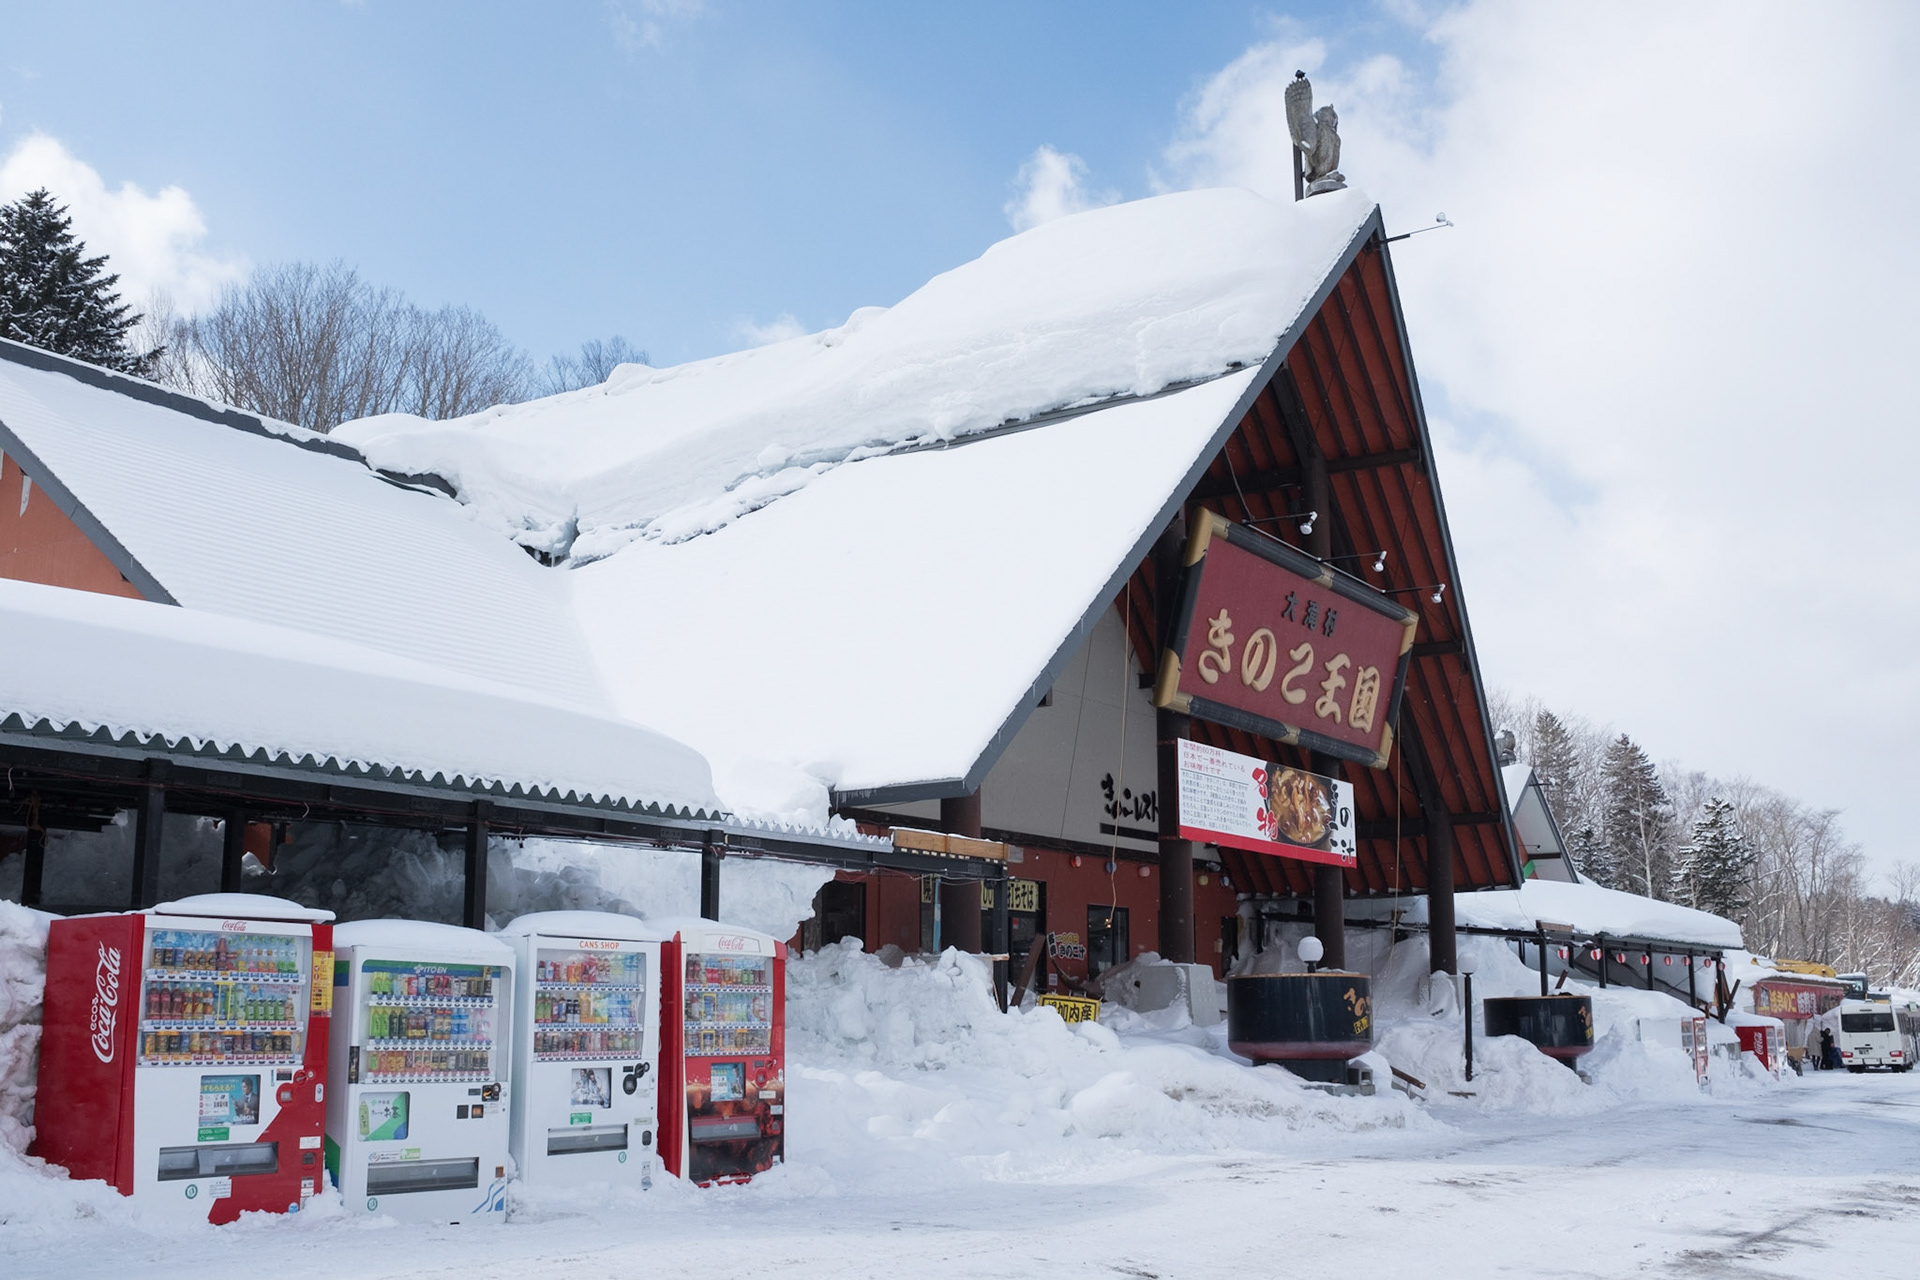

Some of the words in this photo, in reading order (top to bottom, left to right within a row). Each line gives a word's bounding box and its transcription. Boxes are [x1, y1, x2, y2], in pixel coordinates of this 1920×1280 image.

[222, 920, 248, 932] Coca-Cola
[579, 940, 598, 949] CANS
[601, 941, 620, 950] SHOP
[423, 965, 436, 973] ITO
[92, 940, 121, 1063] Coca-Cola
